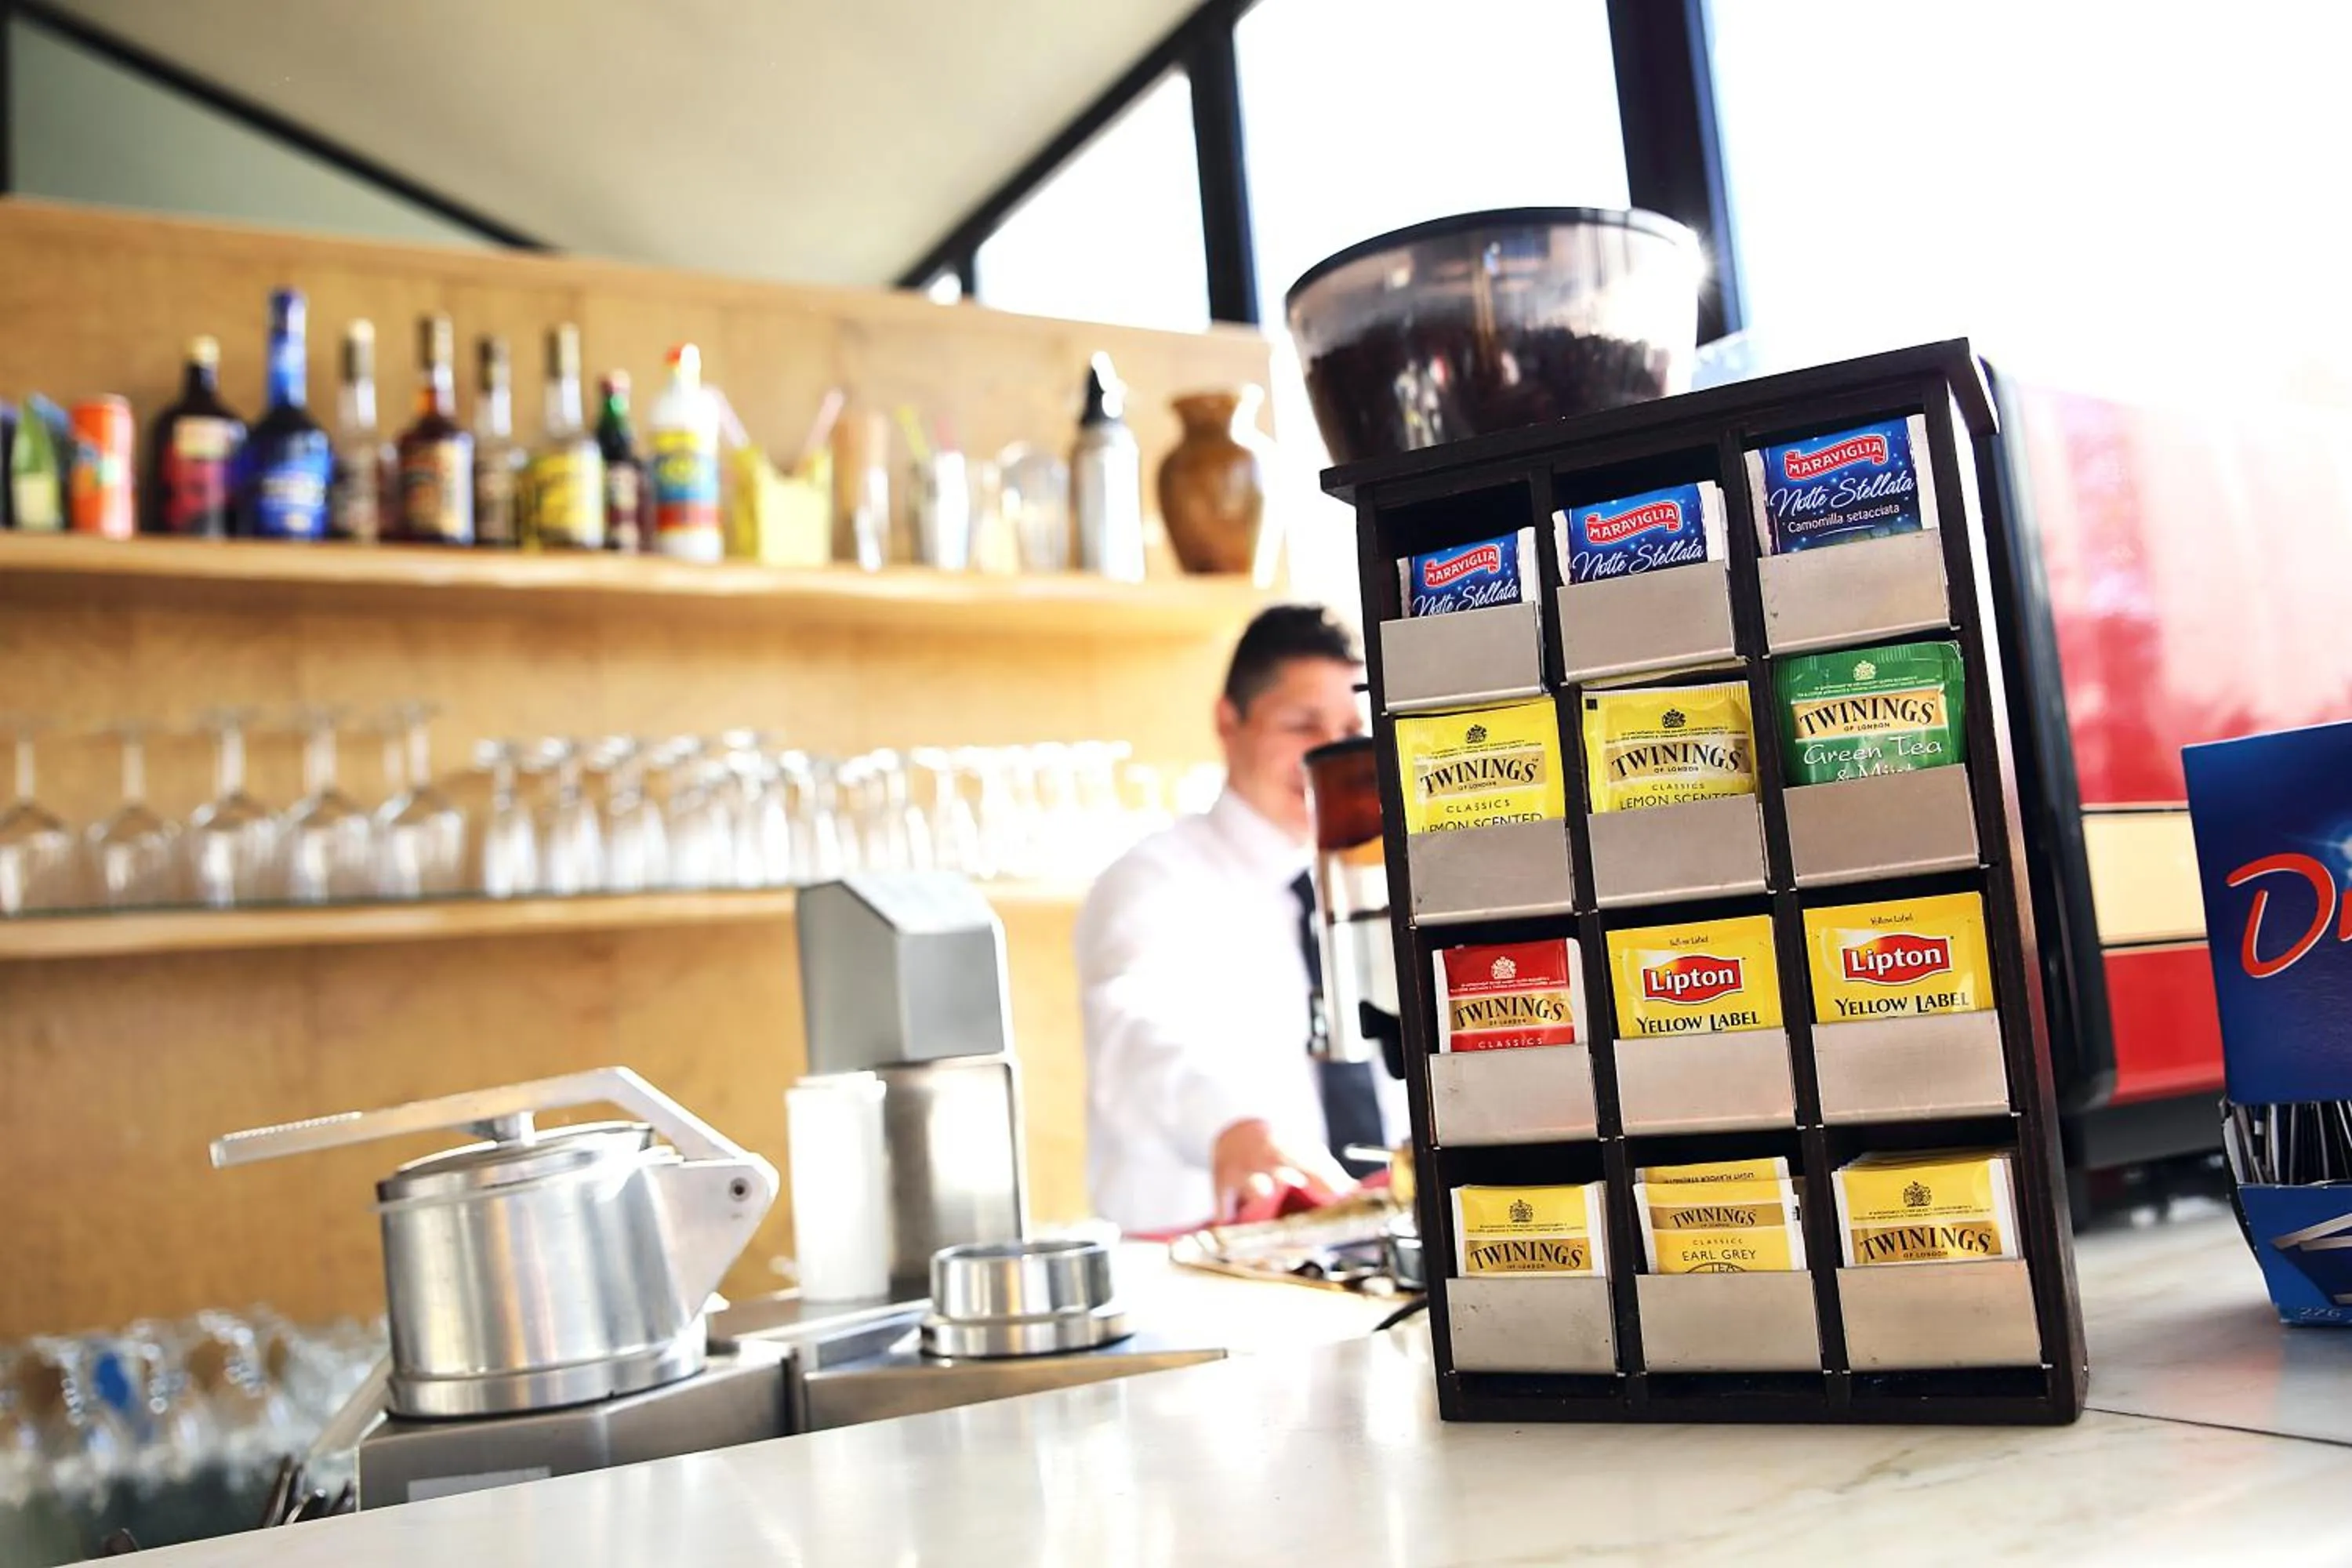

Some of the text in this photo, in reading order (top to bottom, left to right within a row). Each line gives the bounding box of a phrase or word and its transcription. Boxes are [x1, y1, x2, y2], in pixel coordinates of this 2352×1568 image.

[1788, 441, 1882, 474] MARAVIGLIA
[1769, 470, 1915, 517] Notte Stellata
[1589, 508, 1677, 539] MARAVIGLIA
[1788, 503, 1900, 534] Camomilla setacciata
[1426, 549, 1497, 583] MARAVIGLIA
[1572, 537, 1704, 581] Notte Stellata
[1457, 578, 1519, 611] Stellata
[1799, 697, 1935, 735] TWININGS
[1857, 722, 1891, 731] LONDON
[1611, 742, 1743, 777] TWININGS
[1804, 735, 1943, 765] Green Tea
[1420, 758, 1537, 794] TWININGS
[1652, 782, 1705, 791] CLASSICS
[1446, 799, 1510, 813] CLASSICS
[1620, 795, 1669, 810] LEMON
[1851, 947, 1942, 976] Lipton
[1650, 967, 1734, 995] Lipton
[1455, 996, 1565, 1027] TWININGS
[1835, 992, 1969, 1016] YELLOW LABEL
[1636, 1011, 1760, 1034] YELLOW LABEL
[1478, 1037, 1543, 1048] CLASSICS
[1669, 1207, 1756, 1229] TWININGS
[1470, 1241, 1584, 1269] TWININGS
[1682, 1248, 1756, 1261] EARL GREY
[1860, 1226, 1991, 1260] TWININGS
